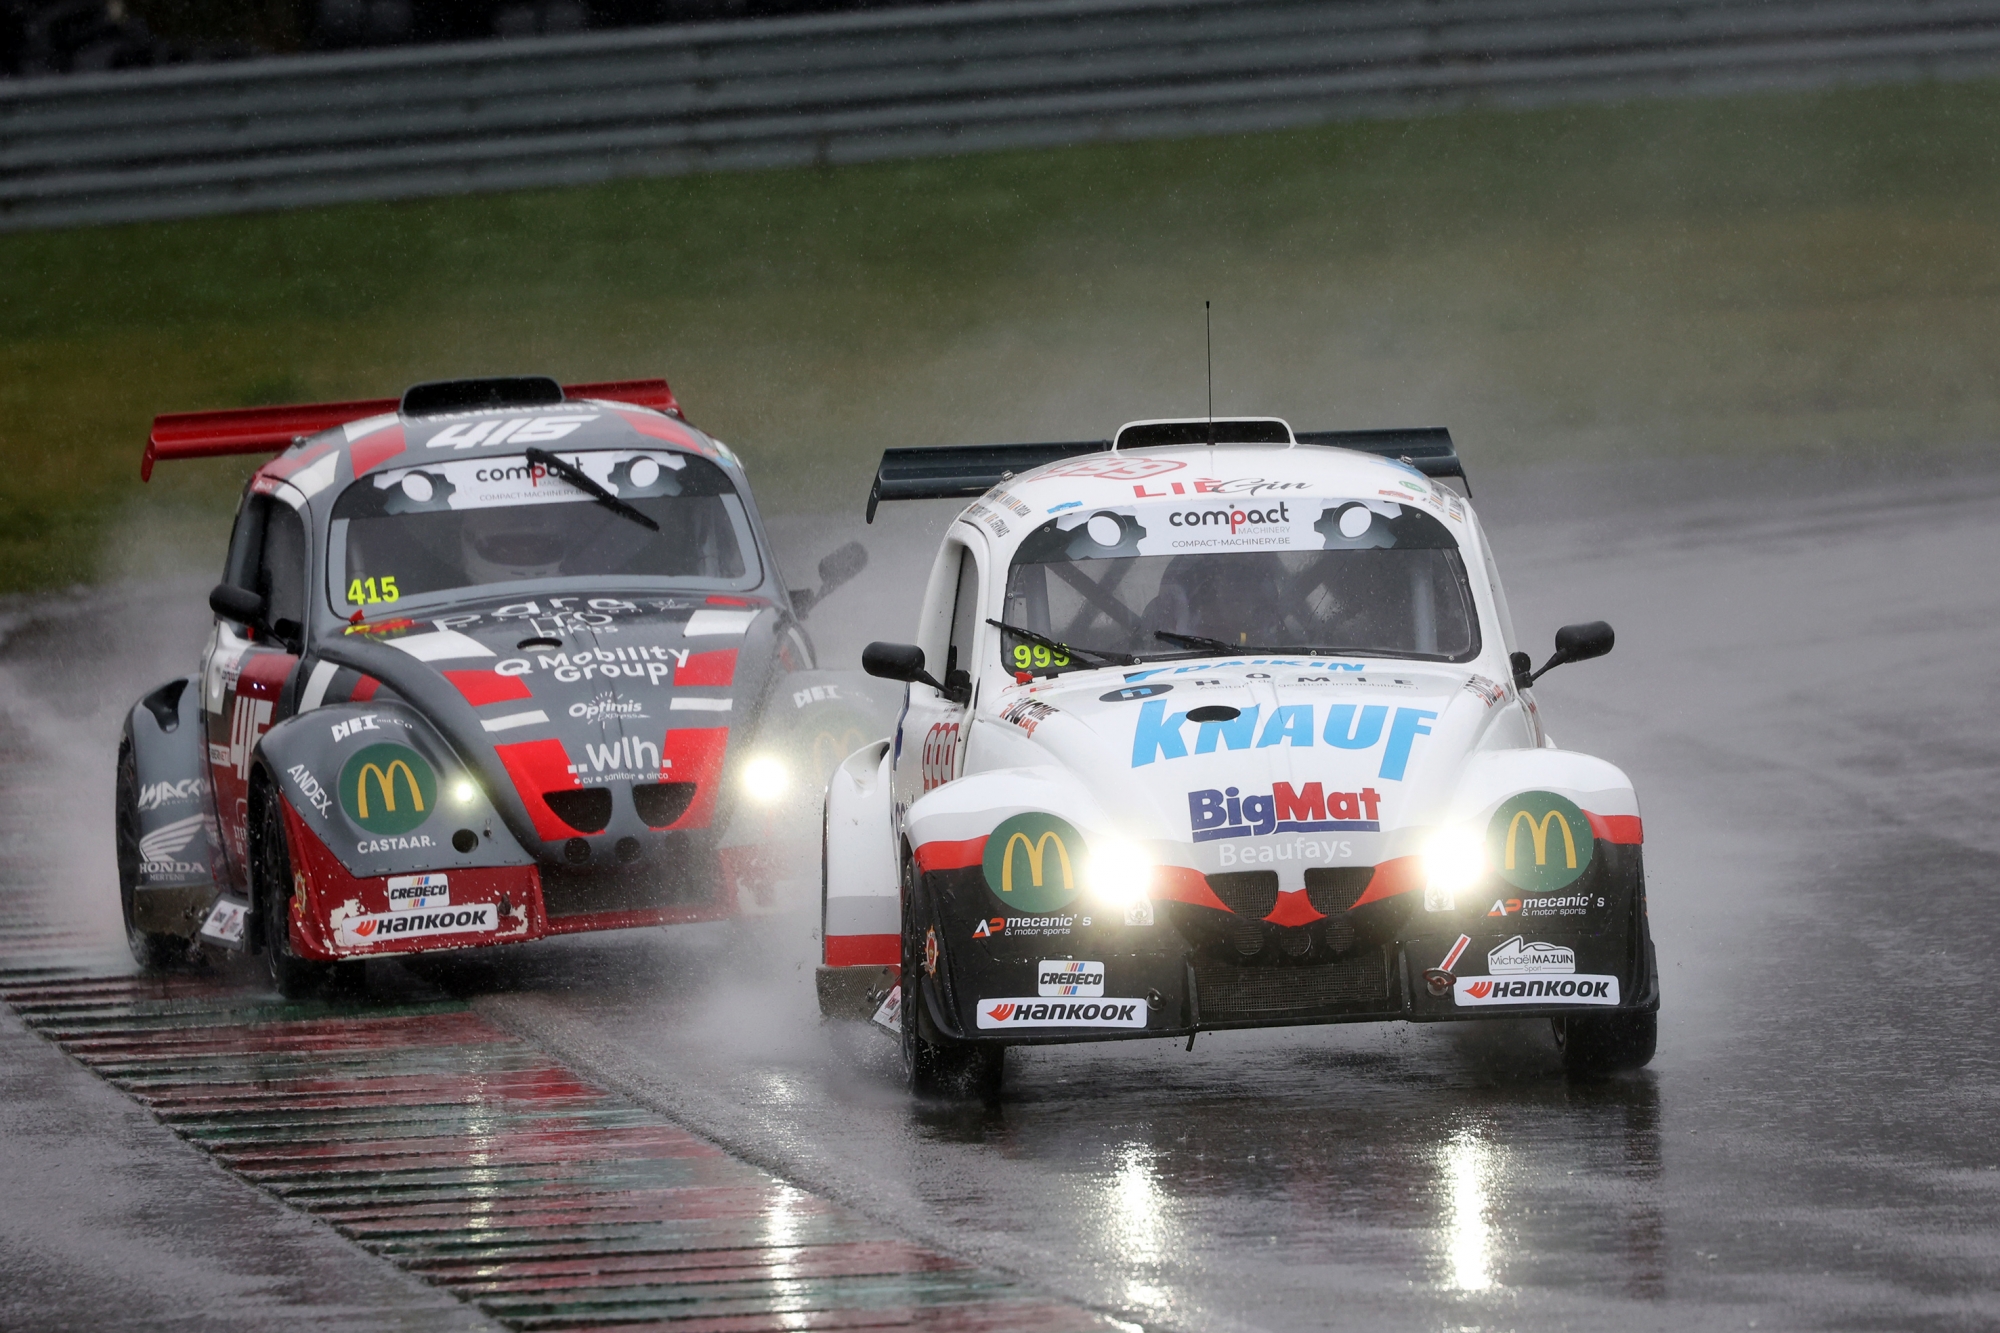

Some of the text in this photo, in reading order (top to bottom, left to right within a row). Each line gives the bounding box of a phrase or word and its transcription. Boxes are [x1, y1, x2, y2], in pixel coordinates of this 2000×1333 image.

[426, 414, 601, 450] 415
[1168, 501, 1290, 535] compact
[1237, 526, 1291, 535] MACHINERY
[1171, 537, 1291, 548] COMPACT-MACHINERY.BE
[347, 576, 400, 606] 415
[537, 646, 691, 669] Mobility
[554, 661, 669, 686] Group
[568, 699, 642, 720] Optimis
[1188, 781, 1382, 837] BigMat
[1219, 837, 1353, 867] Beaufays
[139, 861, 206, 874] HONDA
[390, 884, 448, 901] CREDECO
[1521, 906, 1587, 917] & motor sports
[1004, 926, 1071, 937] & motor sports
[1523, 964, 1542, 973] Sport
[1039, 972, 1103, 986] CREDECO
